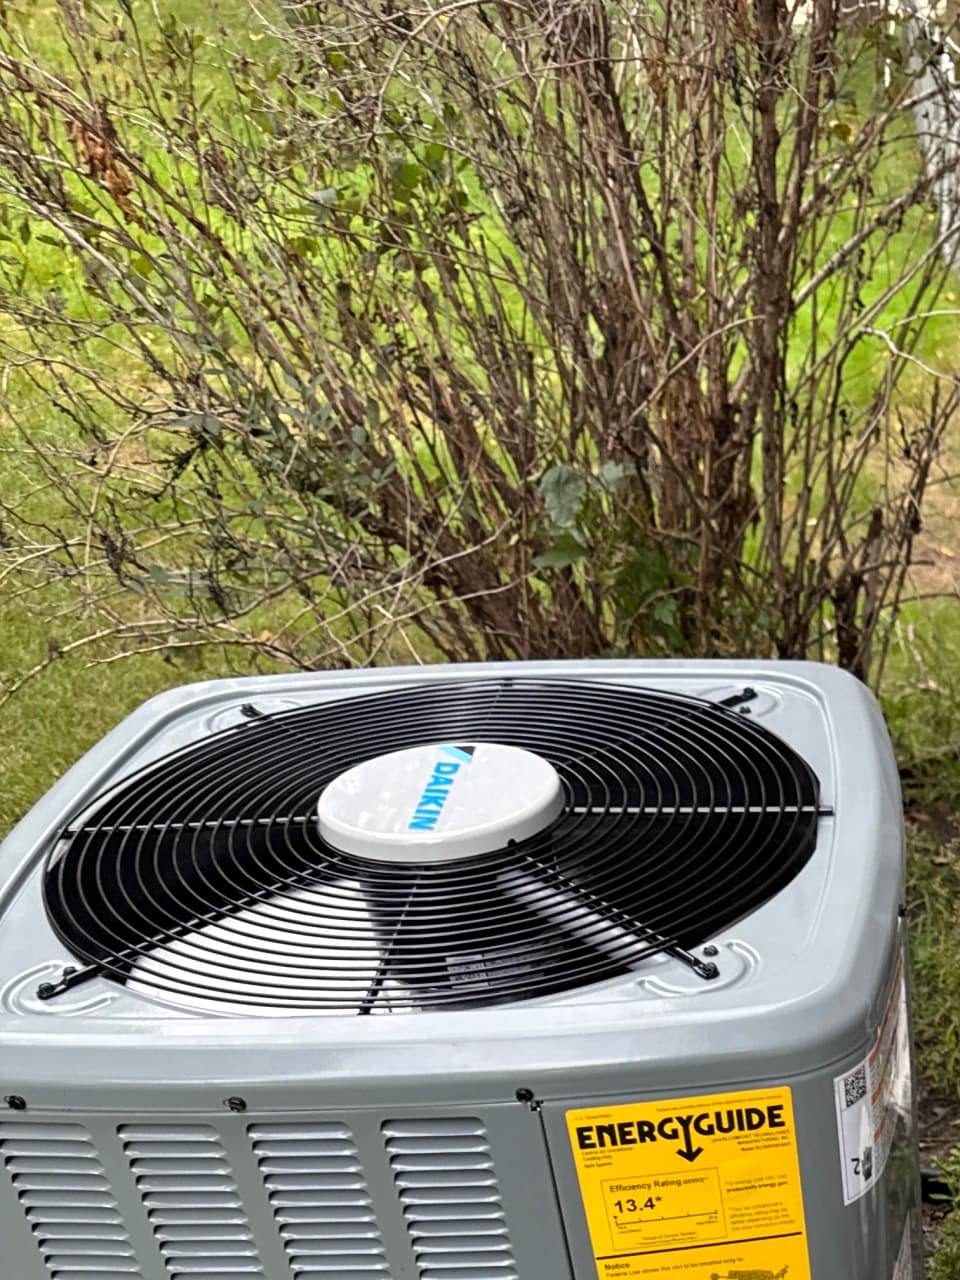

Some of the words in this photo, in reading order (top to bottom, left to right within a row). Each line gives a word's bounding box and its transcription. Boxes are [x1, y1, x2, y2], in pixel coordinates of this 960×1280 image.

[408, 761, 461, 831] DAIKIN
[576, 1104, 785, 1151] ENERGYGUIDE
[609, 1181, 652, 1194] Efficiency
[654, 1177, 682, 1189] Rating
